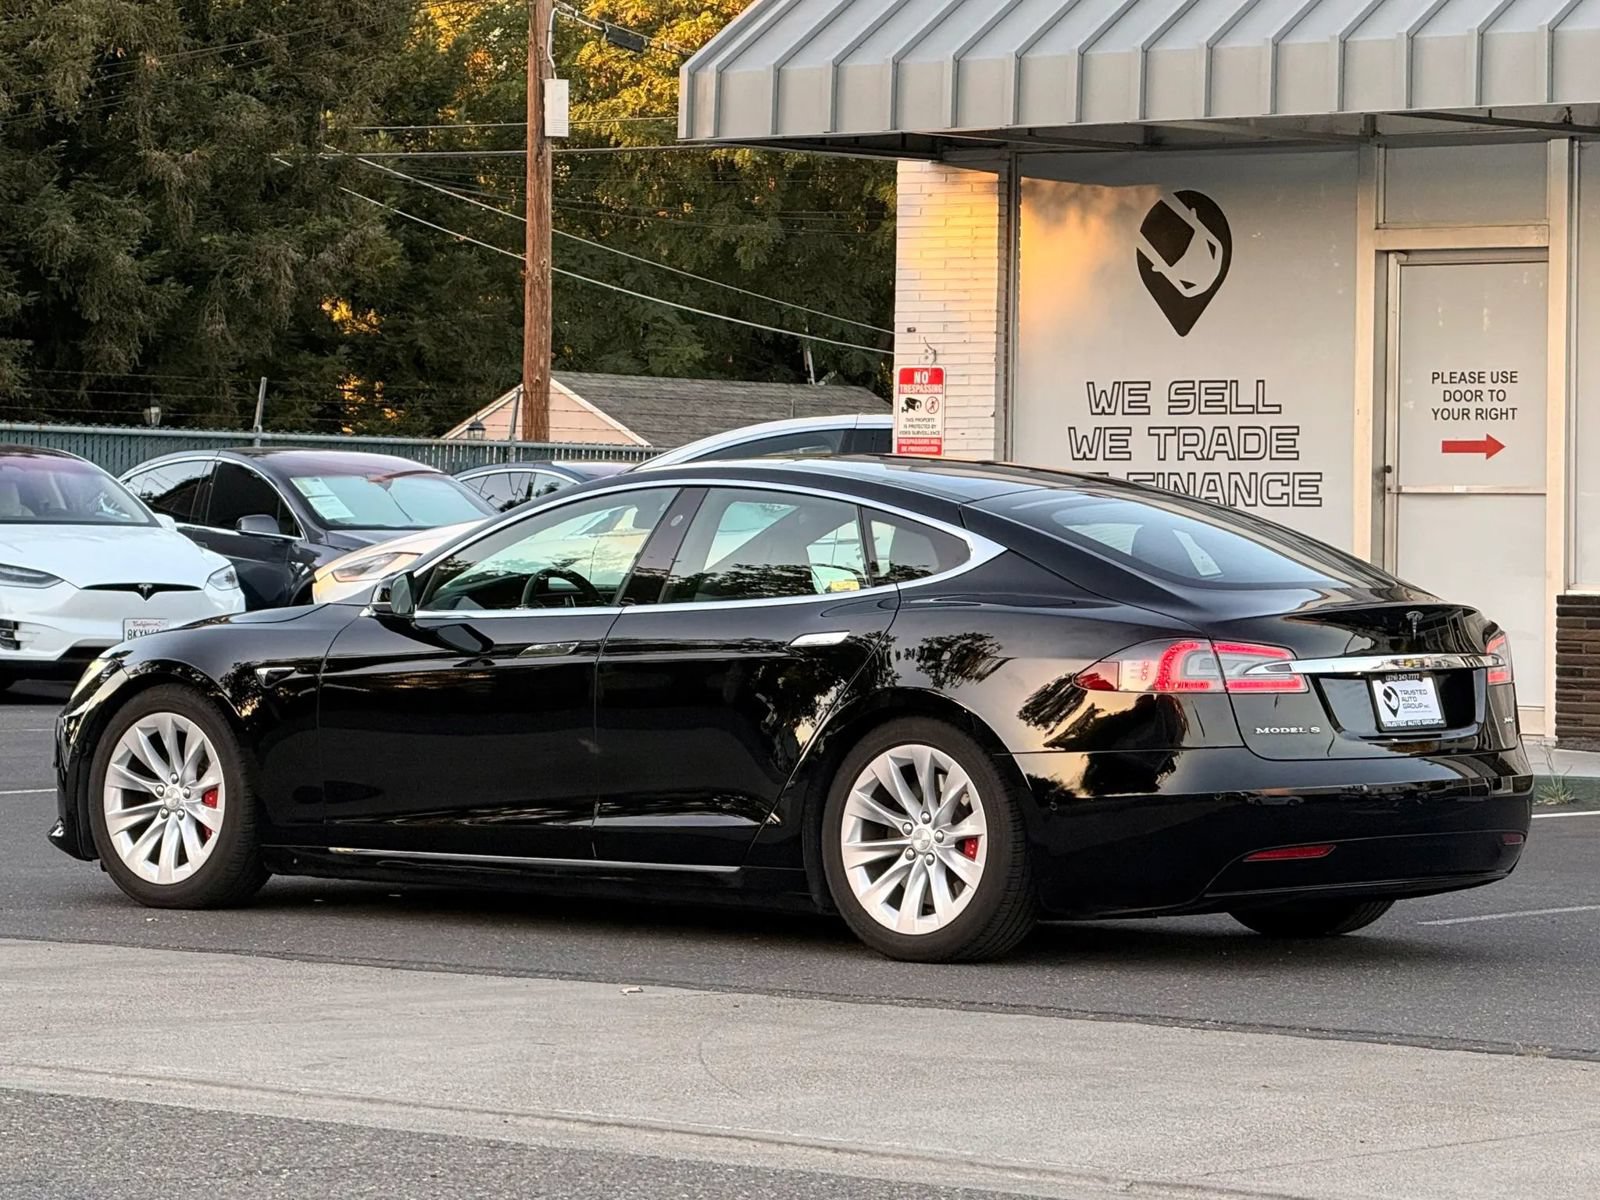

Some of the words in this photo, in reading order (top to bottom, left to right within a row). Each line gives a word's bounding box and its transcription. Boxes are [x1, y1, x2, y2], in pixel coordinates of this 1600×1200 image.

[914, 371, 929, 385] NO
[1431, 371, 1486, 384] PLEASE
[1490, 371, 1518, 384] USE
[900, 384, 943, 394] TRESPASSING
[1443, 389, 1484, 402] DOOR
[1487, 389, 1507, 402] TO
[1086, 381, 1151, 415] WE
[1168, 379, 1282, 415] SELL
[1431, 407, 1471, 421] YOUR
[1475, 407, 1518, 420] RIGHT
[1068, 426, 1132, 461] WE
[1148, 426, 1300, 461] TRADE
[1310, 726, 1321, 734] S
